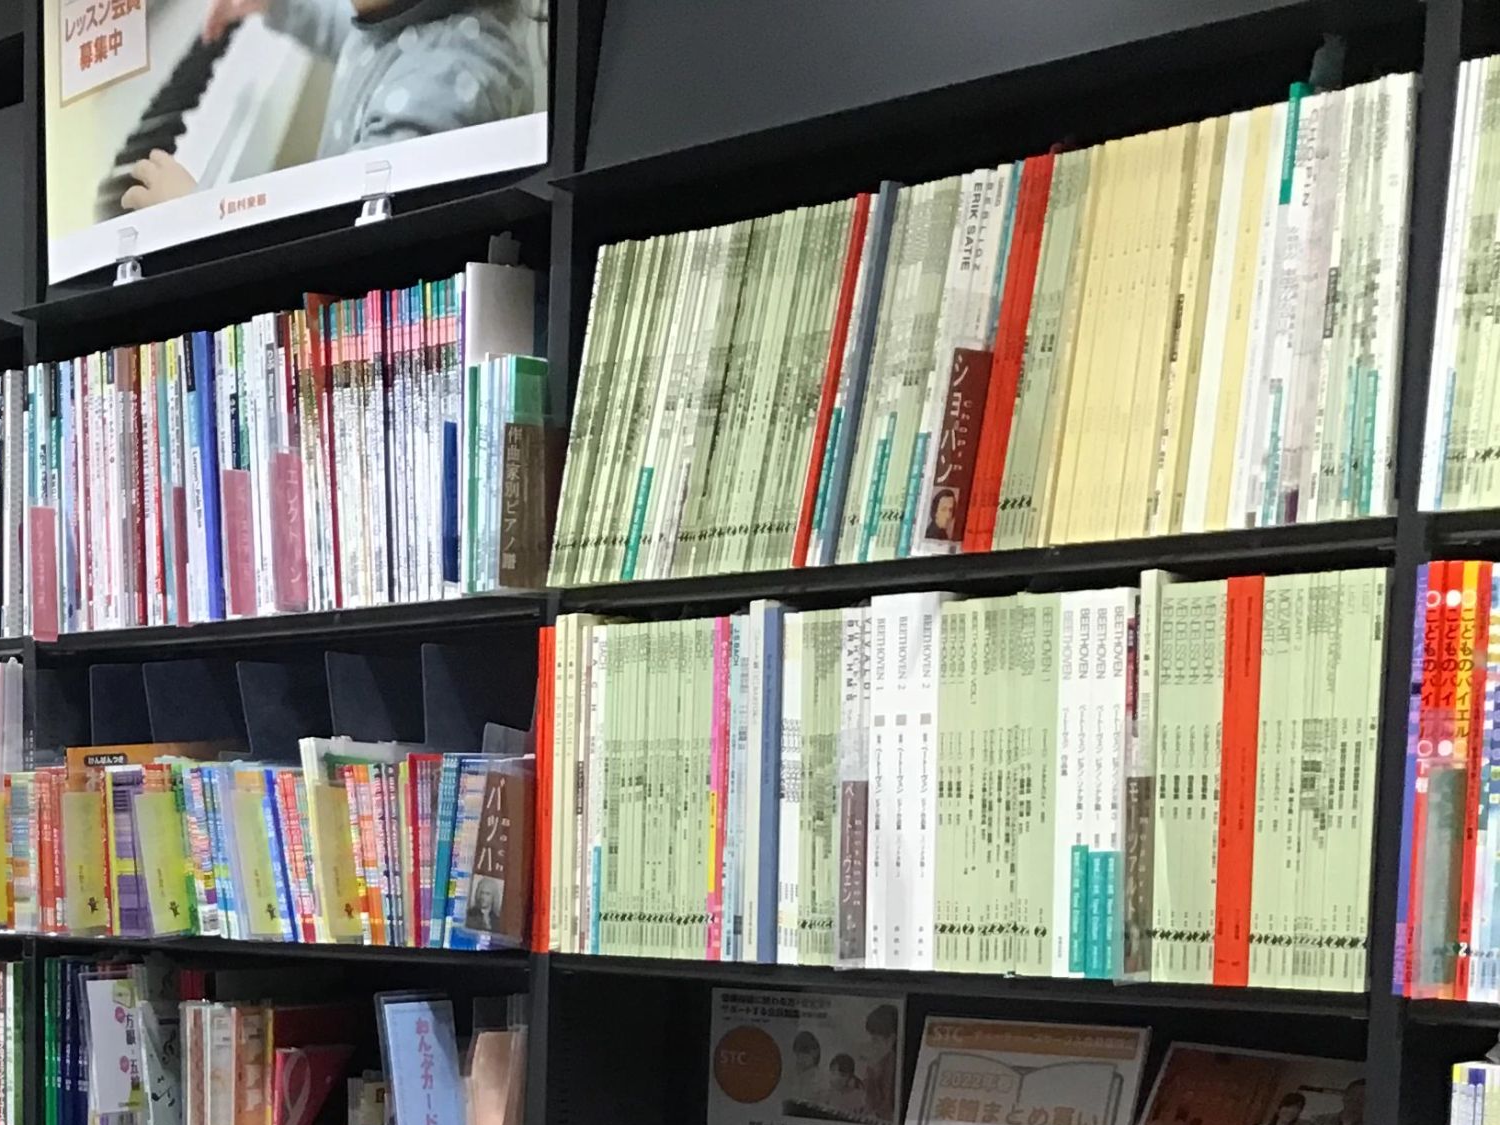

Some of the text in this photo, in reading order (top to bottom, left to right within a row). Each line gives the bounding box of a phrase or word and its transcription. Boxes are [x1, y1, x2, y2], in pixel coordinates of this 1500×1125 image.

[78, 35, 124, 72] 募集中
[1301, 107, 1319, 207] CHOPIN
[960, 182, 983, 271] ERIK SATIE
[935, 354, 969, 484] ショパン
[501, 424, 521, 572] 作曲家別ピアノ譜
[876, 618, 886, 681] BEETHOVEN
[899, 616, 908, 680] BEETHOVEN
[922, 614, 932, 679] BEETHOVEN
[1041, 607, 1052, 673] BEETHOVEN
[1062, 610, 1072, 680] BEETHOVEN
[1078, 608, 1090, 679] BEETHOVEN
[1095, 608, 1107, 679] BEETHOVEN
[1113, 606, 1124, 677] BEETHOVEN
[1160, 596, 1173, 685] MENDELSSOHN
[1174, 596, 1186, 685] MENDELSSOHN
[1189, 596, 1201, 685] MENDELSSOHN
[1203, 596, 1215, 685] MENDELSSOHN
[1264, 590, 1275, 642] MOZART
[1277, 588, 1290, 642] MOZART
[845, 619, 854, 702] BRAHMS
[477, 777, 505, 873] バッハ
[841, 782, 855, 903] ベートーヴェン
[1125, 779, 1140, 913] モーツァルト
[719, 1051, 747, 1065] STC
